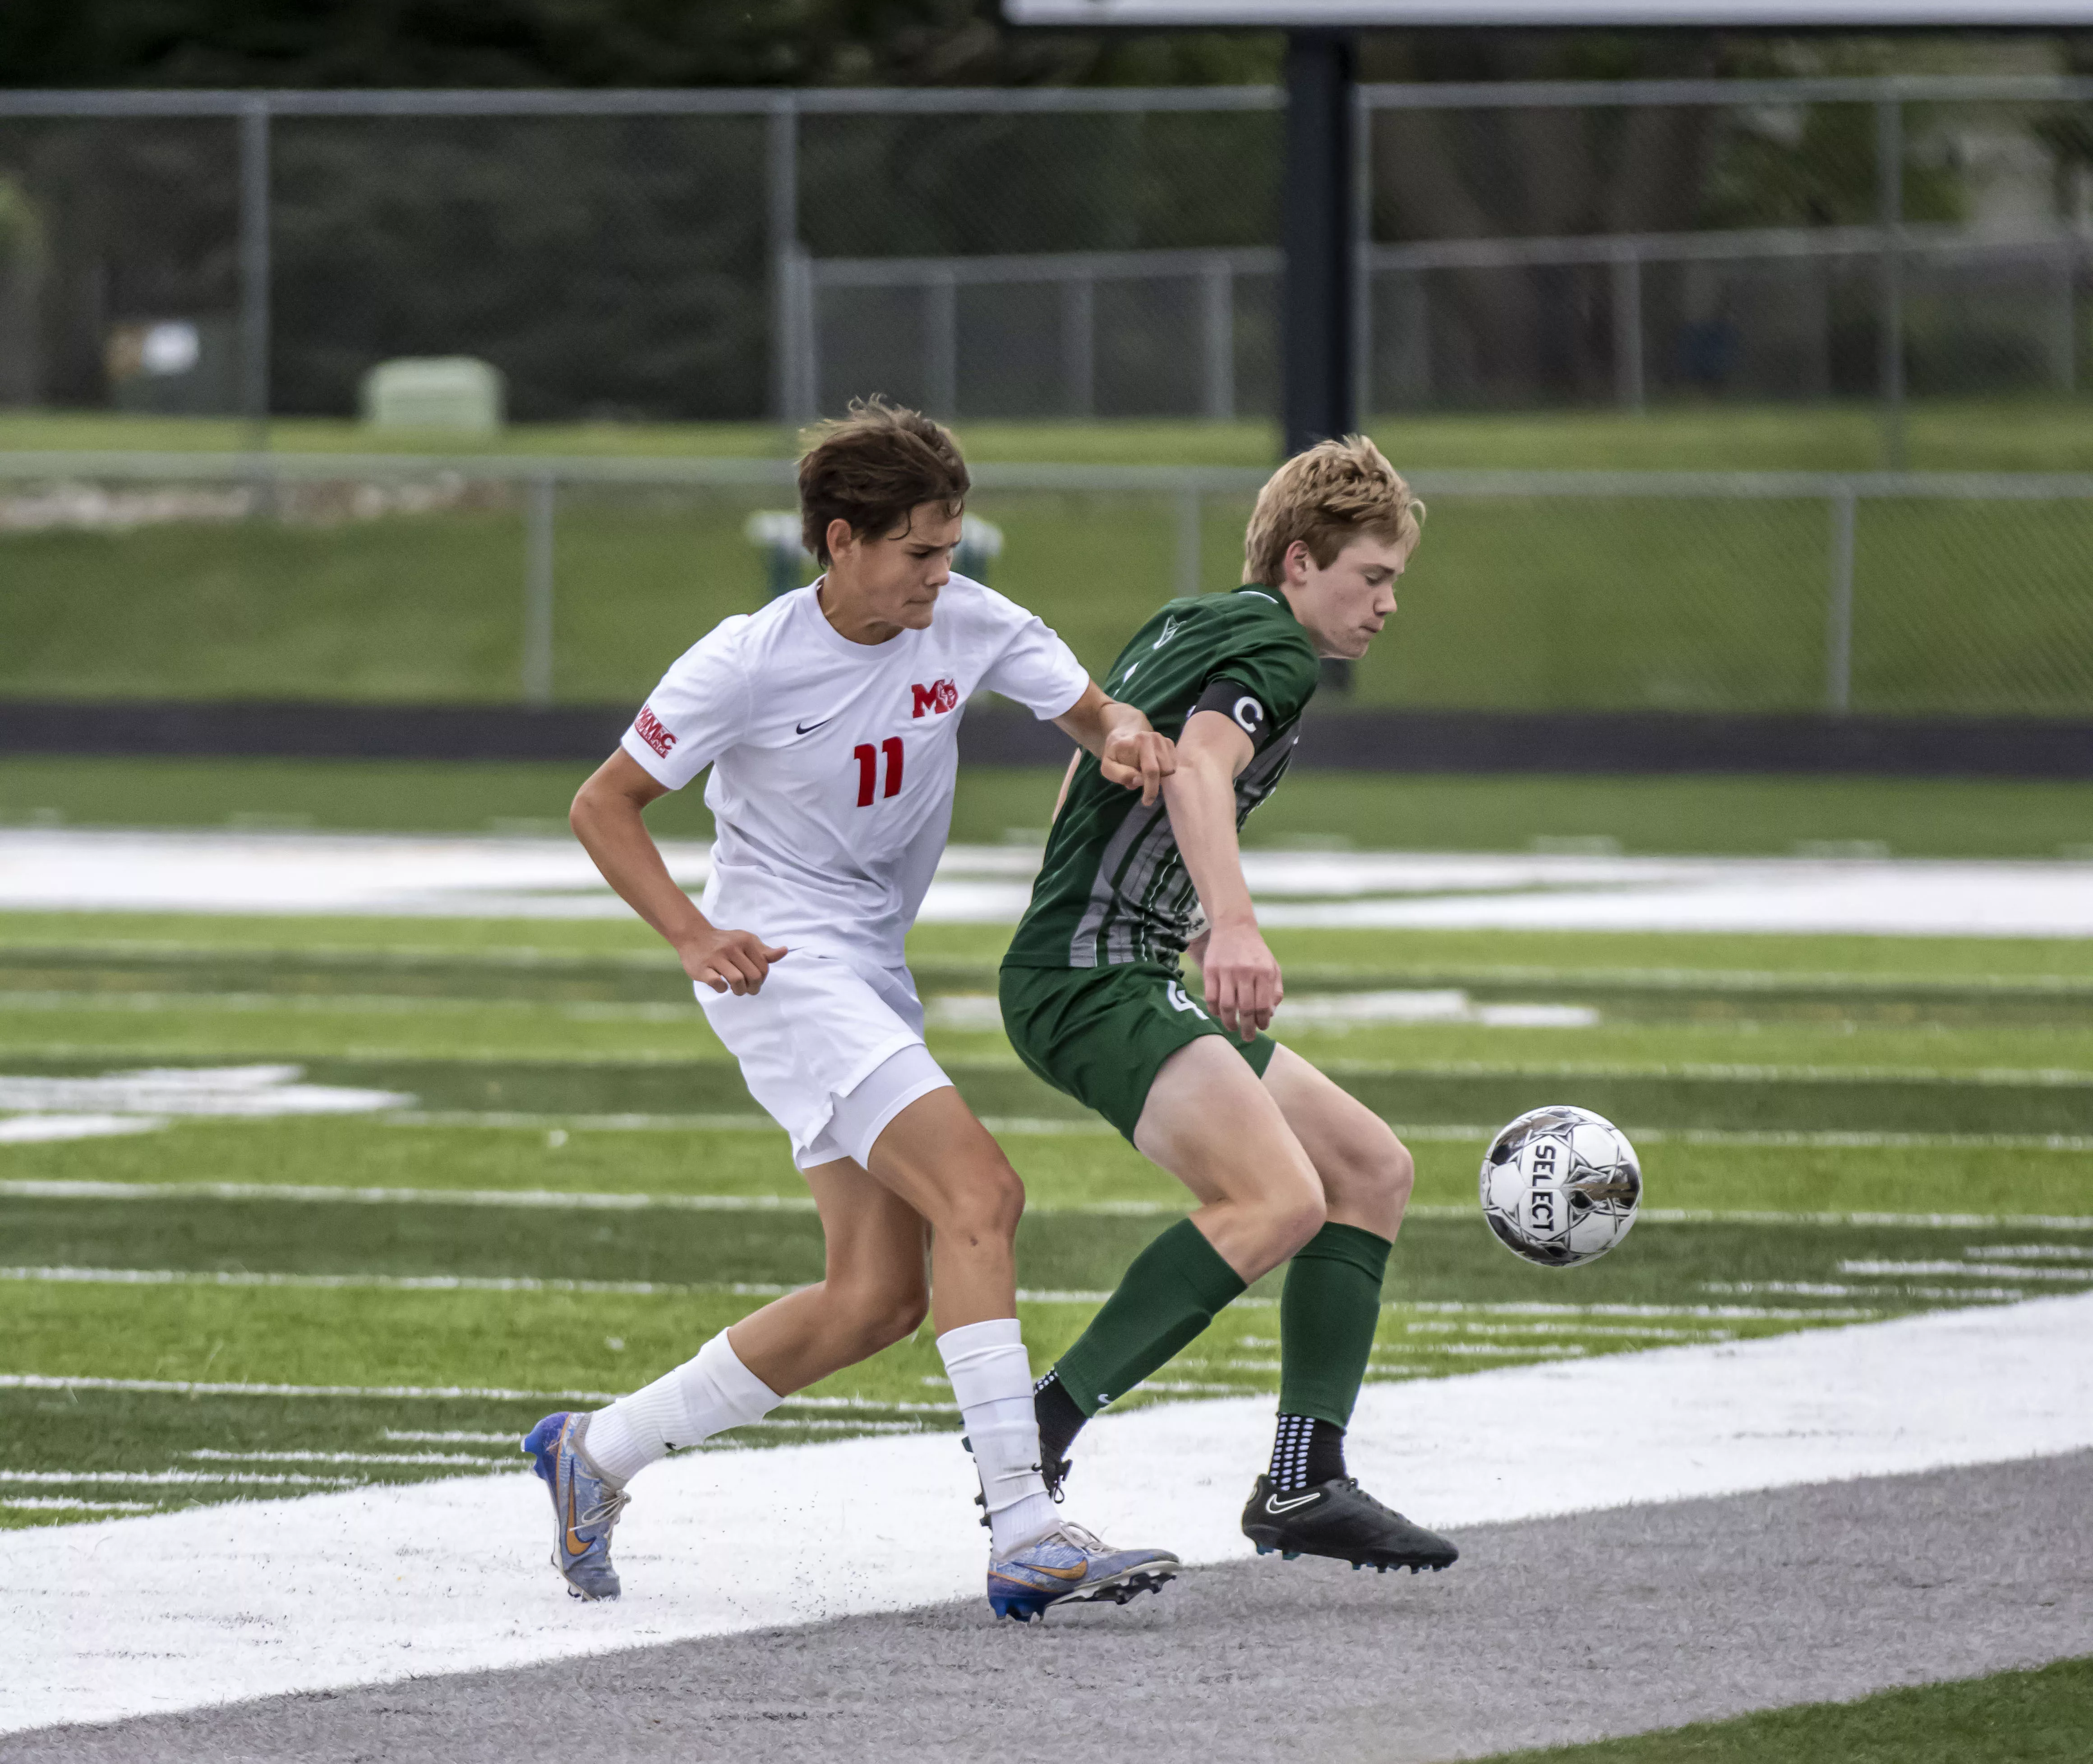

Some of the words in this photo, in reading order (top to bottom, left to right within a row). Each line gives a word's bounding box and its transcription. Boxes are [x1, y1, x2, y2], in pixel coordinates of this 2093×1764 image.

[1232, 696, 1263, 733] C
[853, 734, 904, 807] 11
[1166, 980, 1210, 1020] 4
[1532, 1145, 1557, 1231] SELECT
